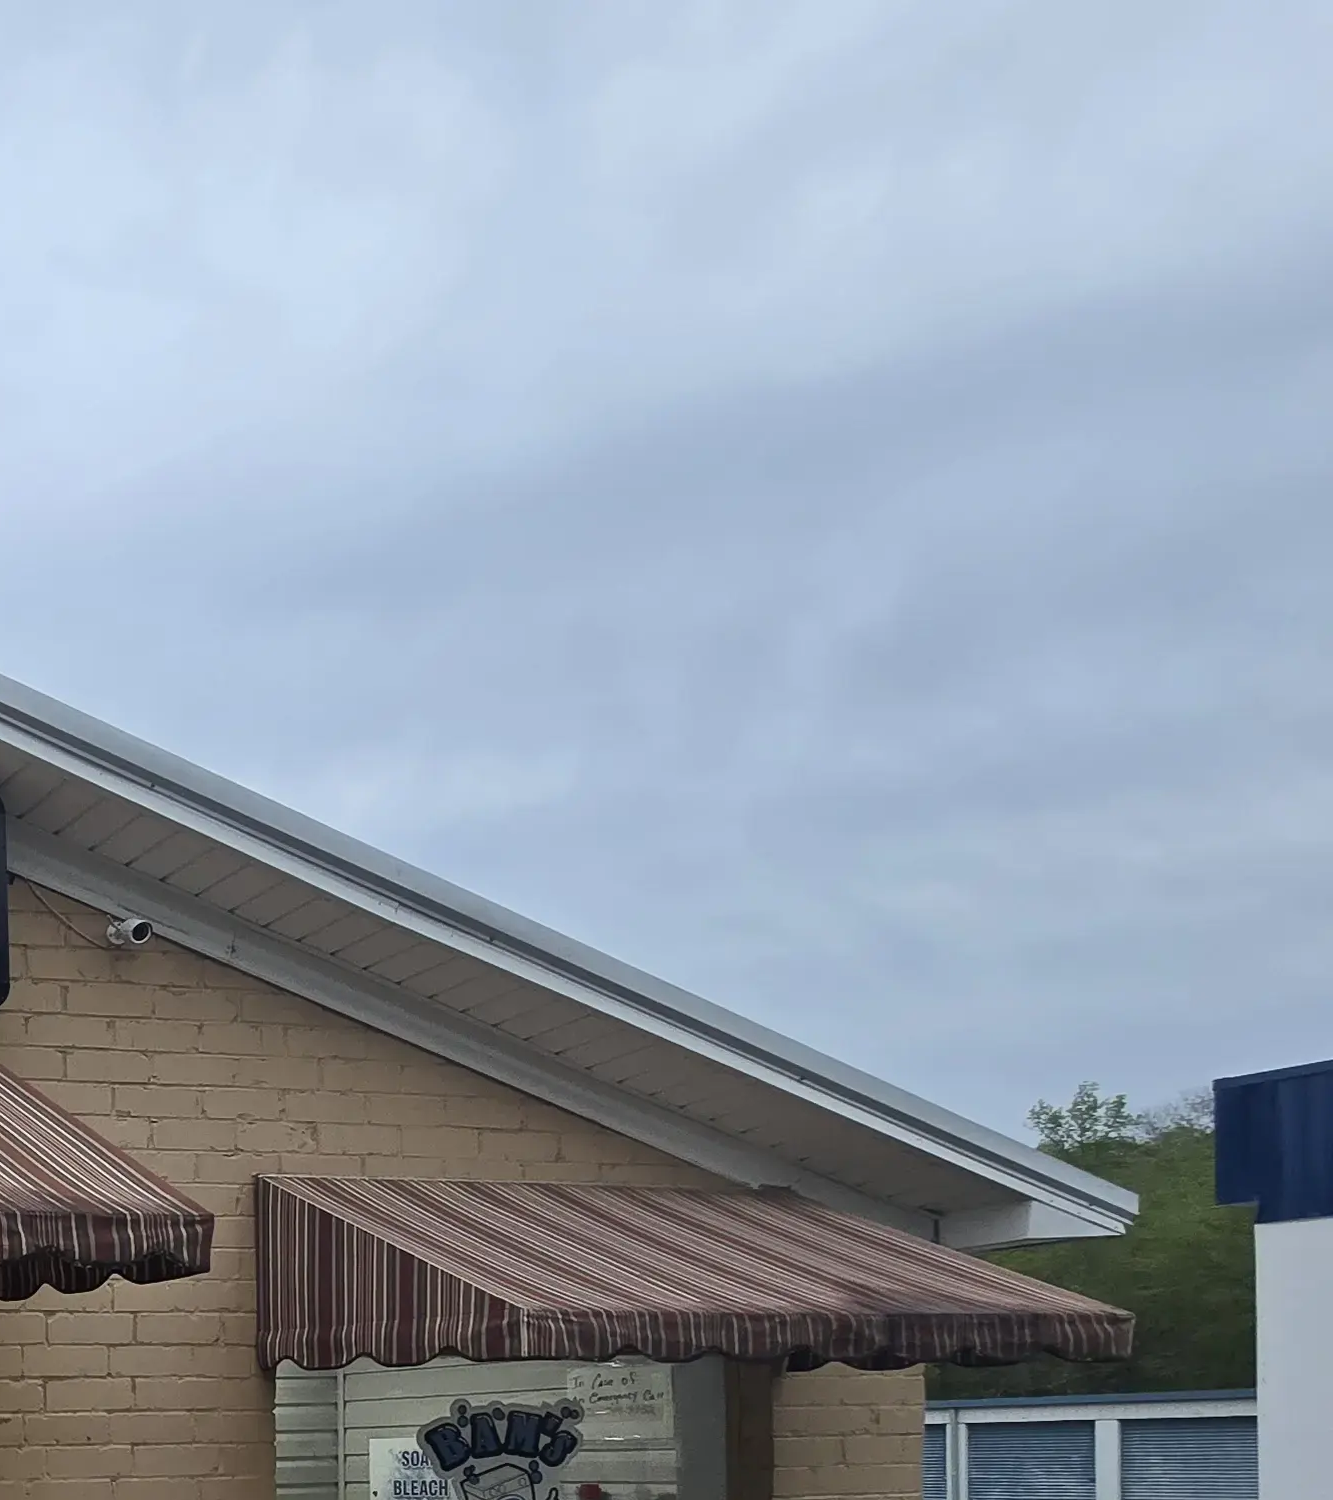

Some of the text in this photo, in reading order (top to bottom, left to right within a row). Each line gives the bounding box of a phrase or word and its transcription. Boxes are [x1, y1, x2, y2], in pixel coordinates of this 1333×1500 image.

[424, 1410, 579, 1472] BAM'S
[401, 1450, 433, 1467] SOA
[393, 1479, 449, 1497] BLEACH
